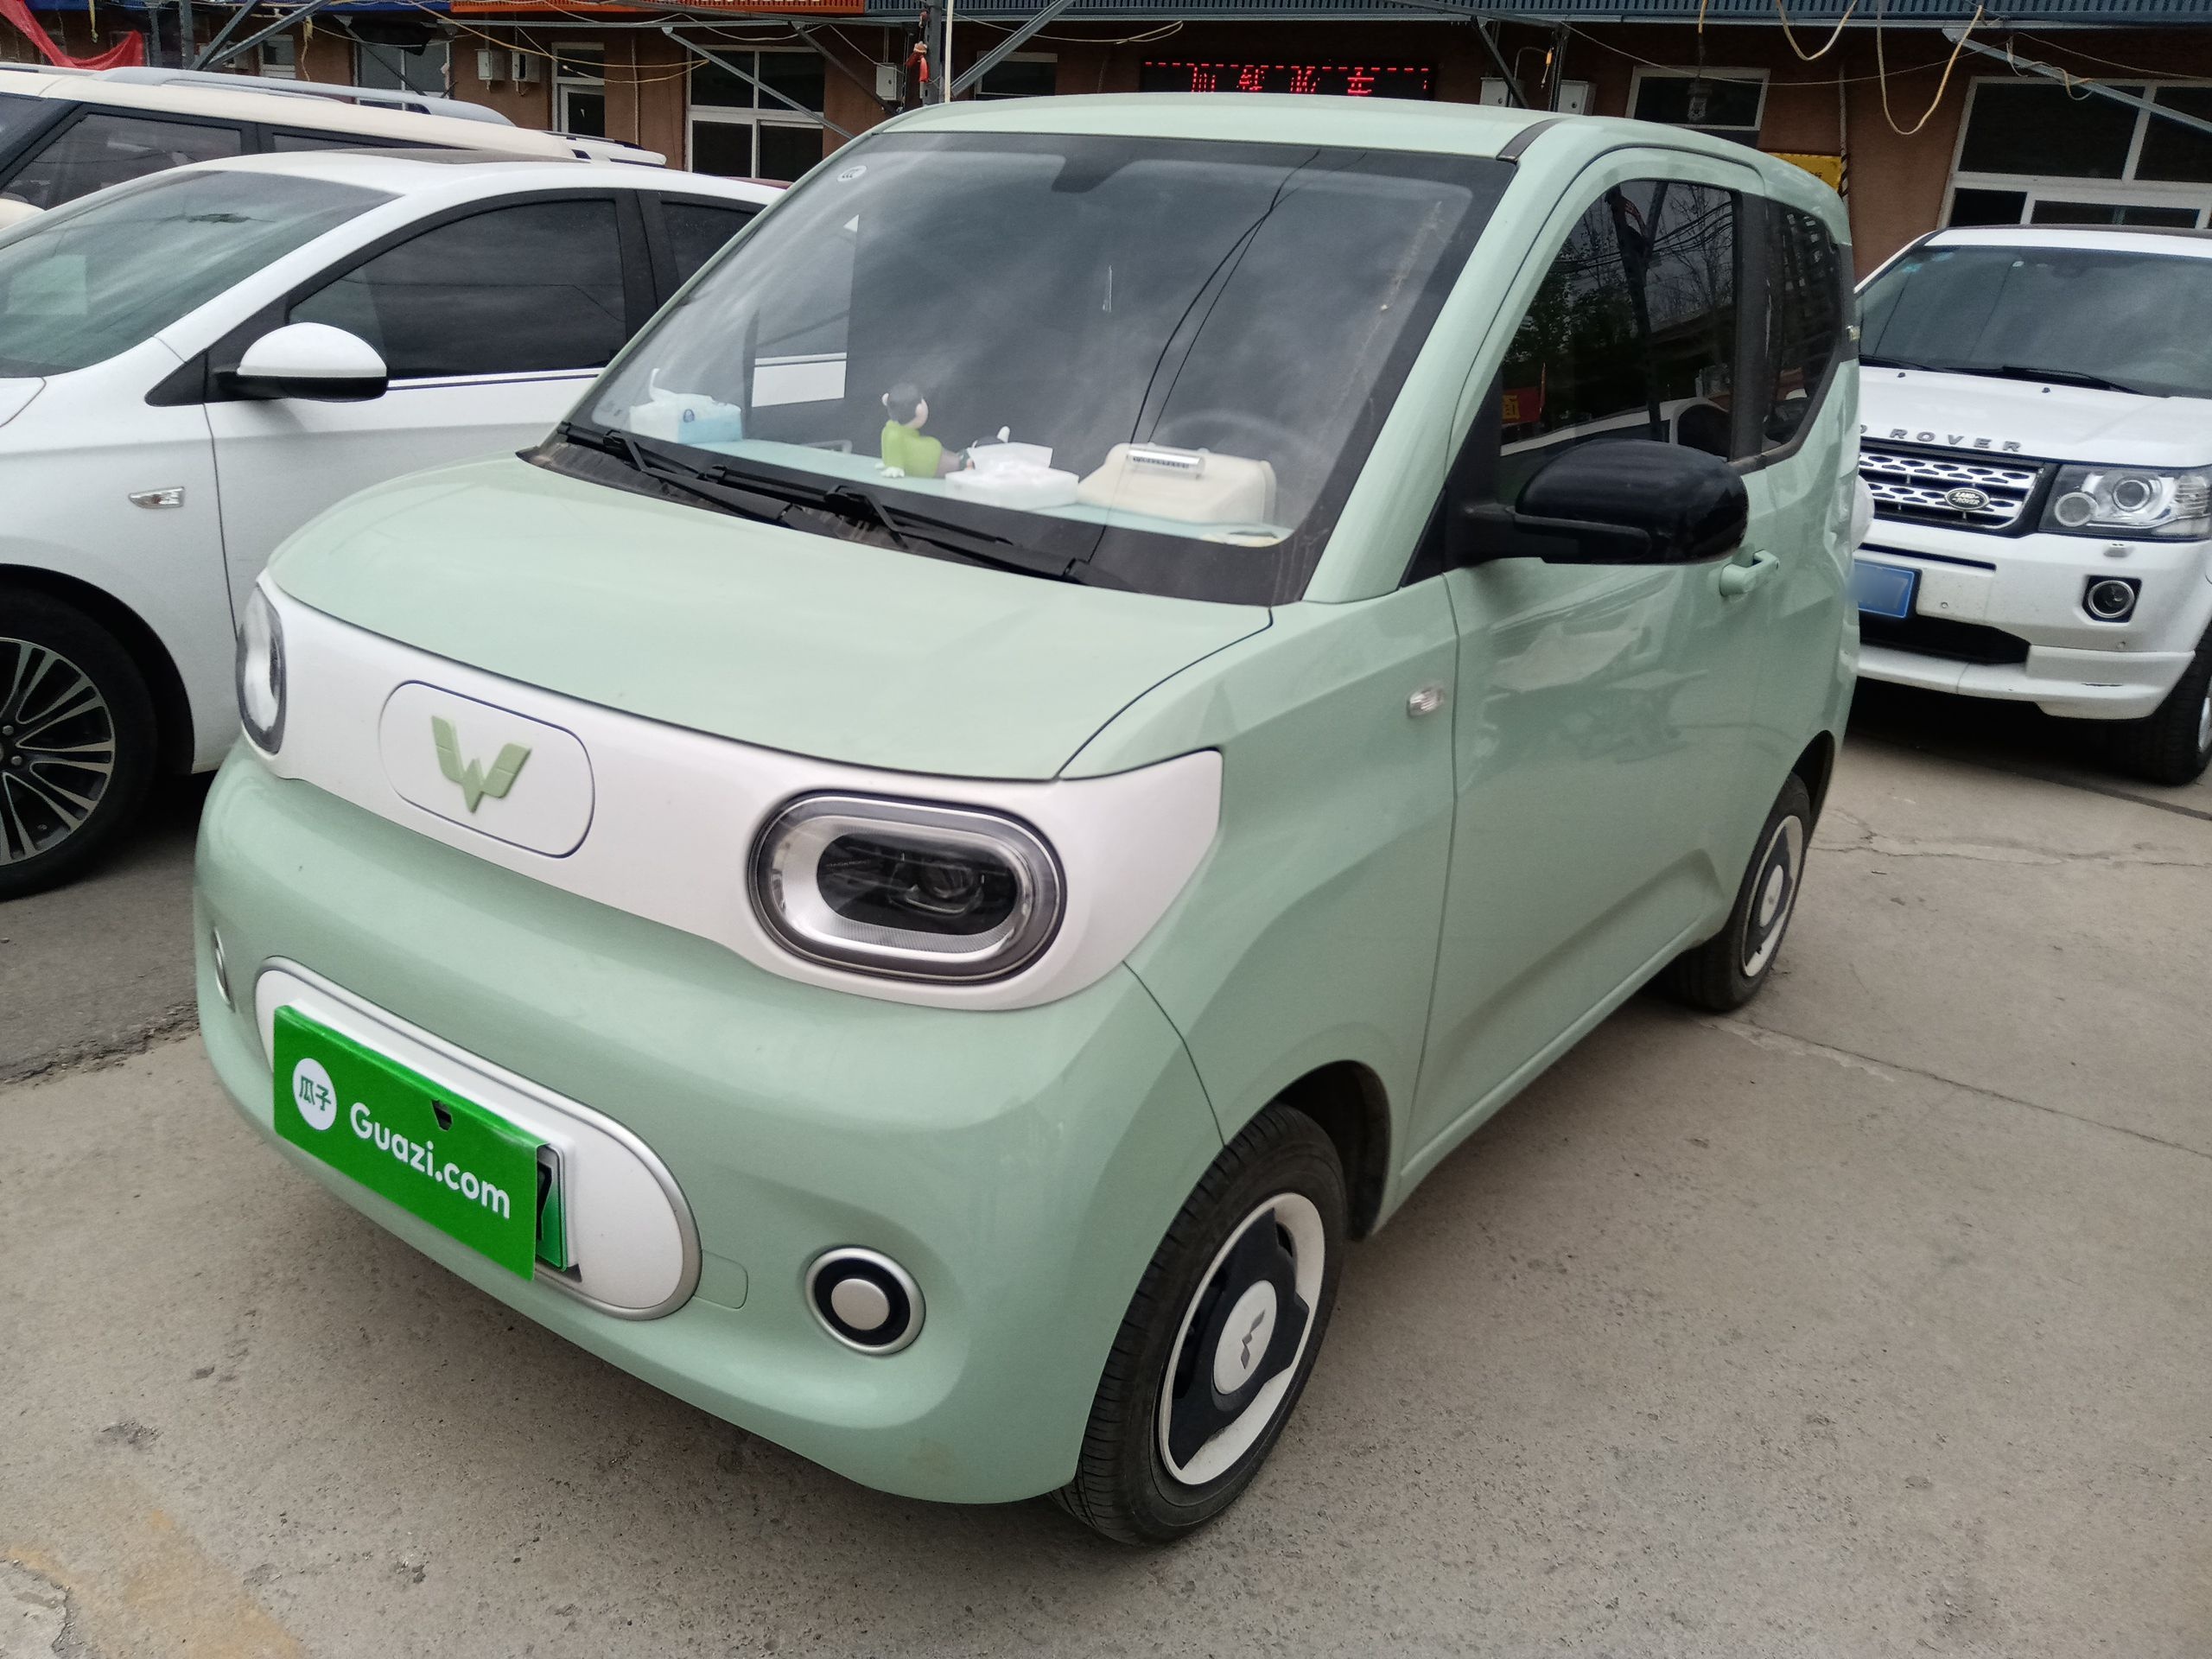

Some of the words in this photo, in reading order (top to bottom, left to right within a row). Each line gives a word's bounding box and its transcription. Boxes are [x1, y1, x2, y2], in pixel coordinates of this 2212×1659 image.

[1890, 428, 2022, 452] ROVER
[299, 1075, 332, 1112] 瓜子
[350, 1102, 512, 1219] Guazi.com
